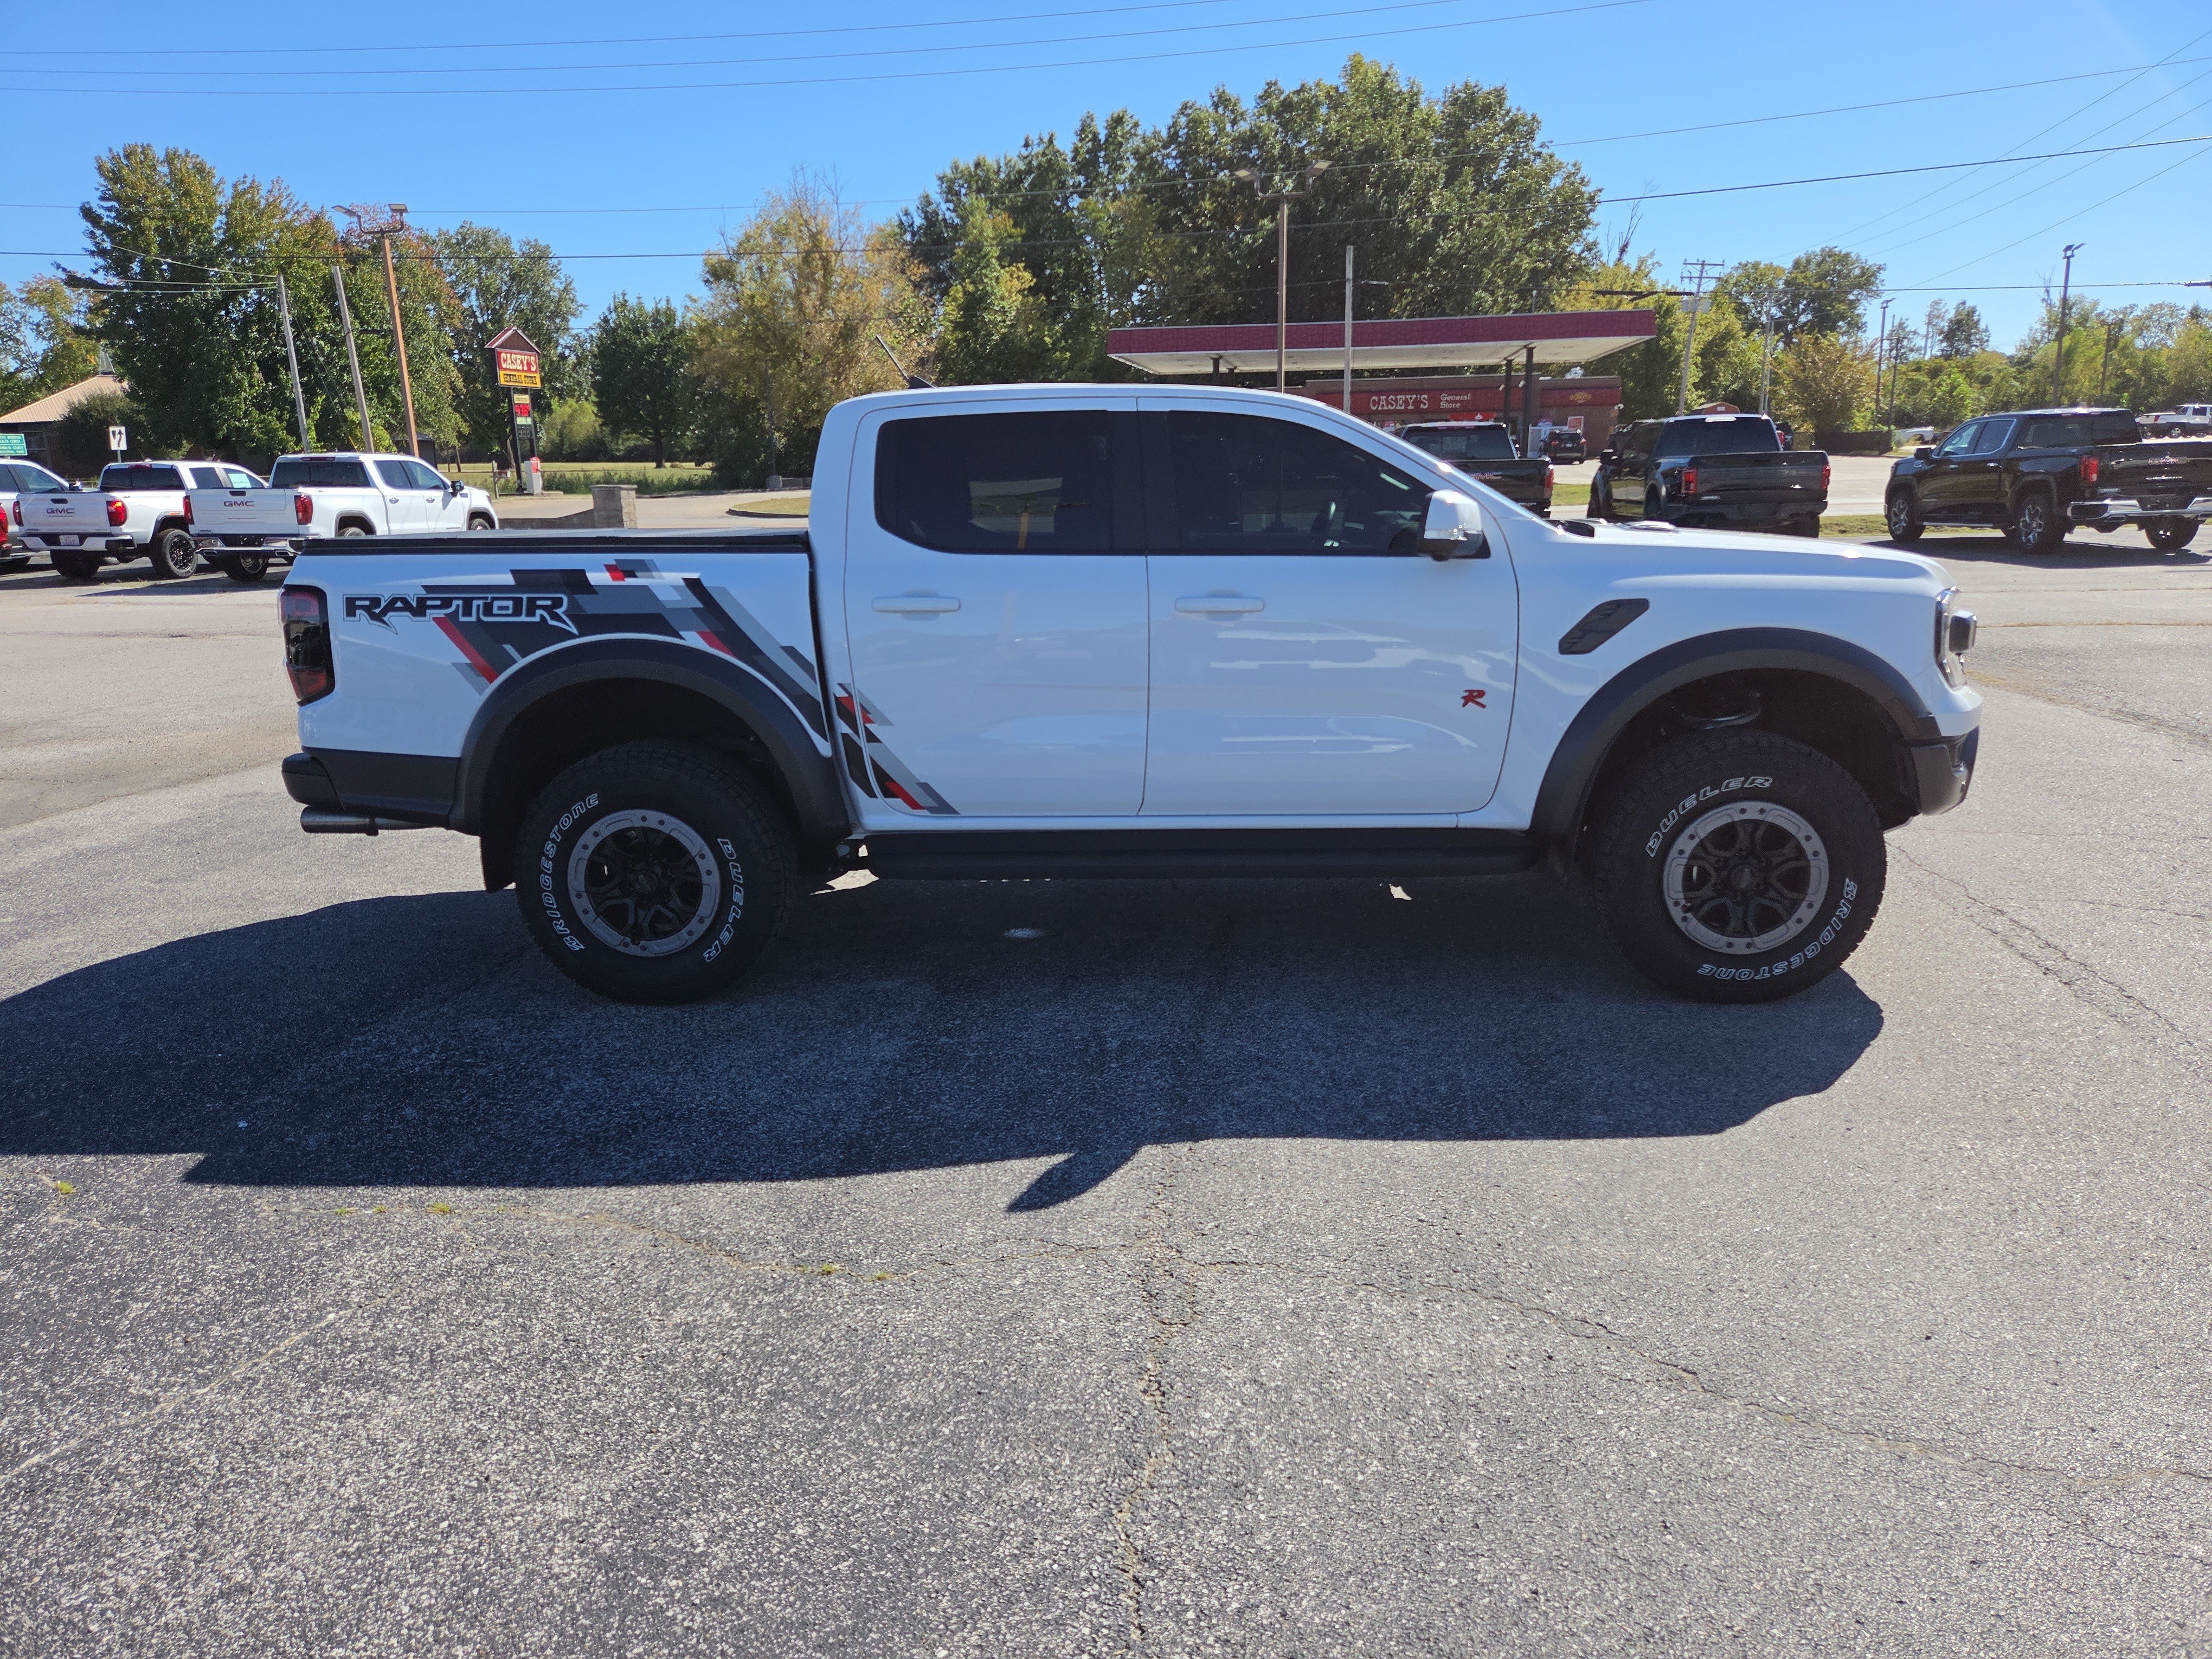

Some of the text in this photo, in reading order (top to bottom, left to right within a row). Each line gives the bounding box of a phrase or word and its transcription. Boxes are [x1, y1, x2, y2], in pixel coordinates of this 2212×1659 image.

[501, 352, 536, 371] CASEY'S
[1369, 394, 1429, 410] CASEY'S
[1440, 393, 1471, 401] General
[343, 593, 579, 635] RAPTOR
[1645, 776, 1773, 858] DUELER
[539, 793, 600, 951] BRIDGESTONE
[703, 838, 745, 963] DUELER
[1696, 877, 1858, 981] BRIDGESTONE
